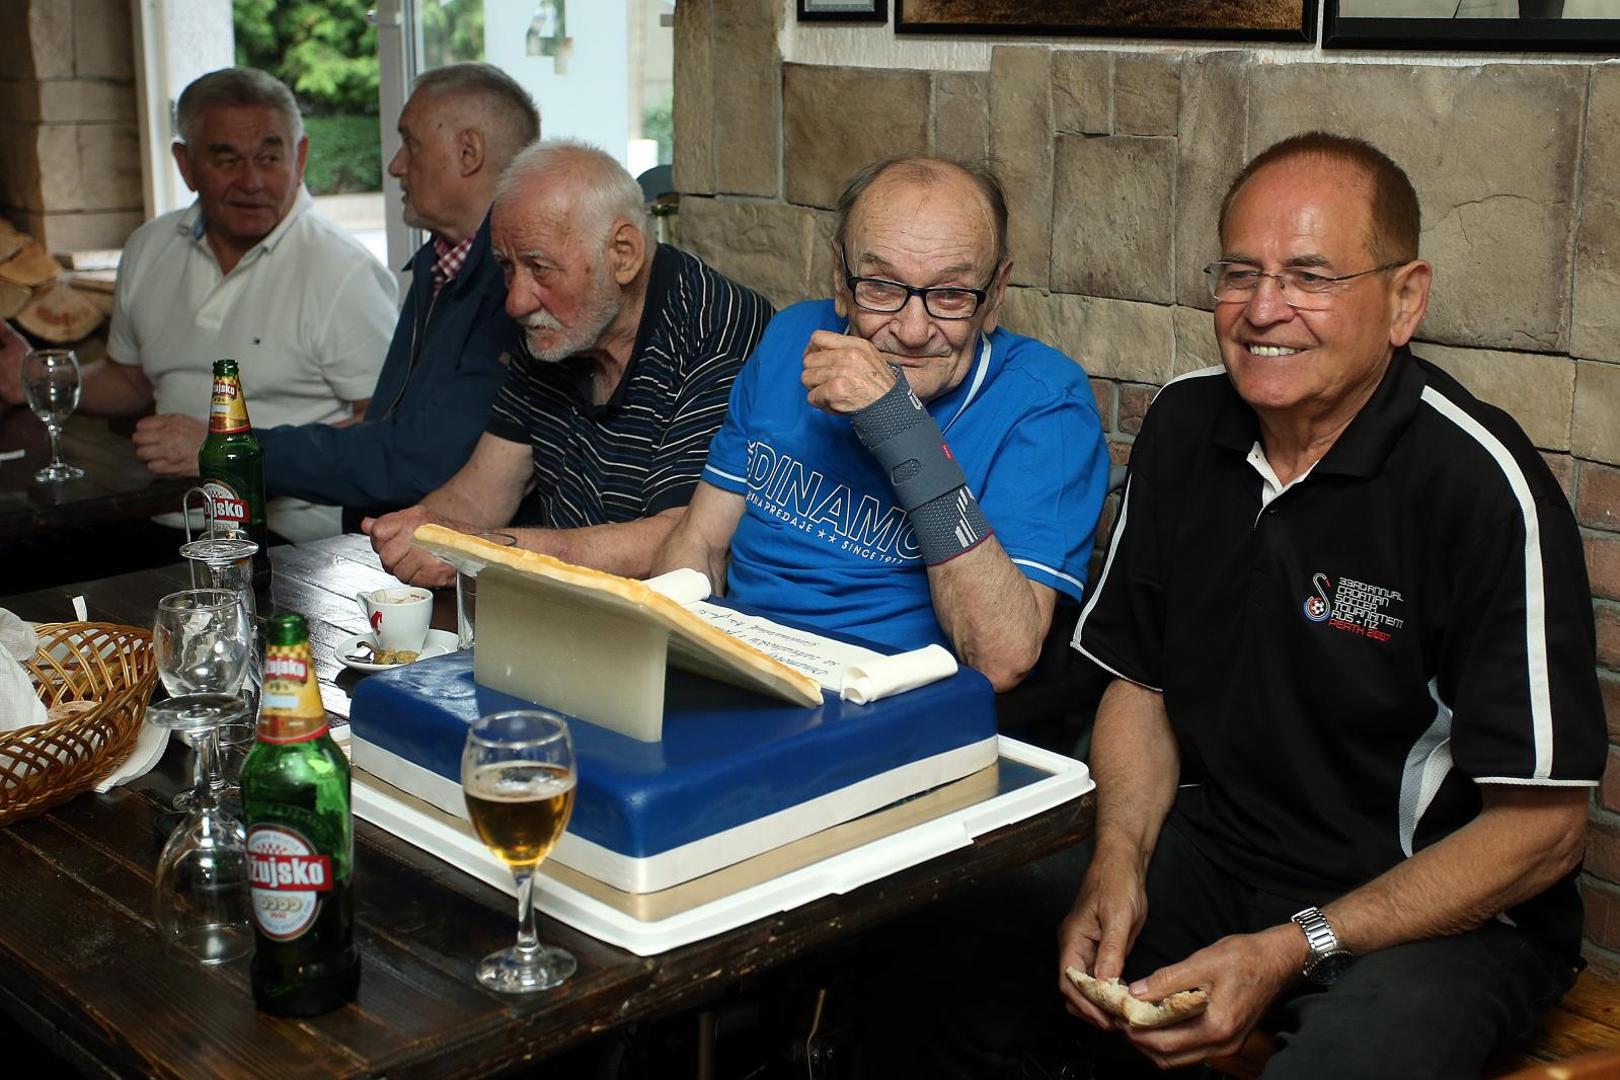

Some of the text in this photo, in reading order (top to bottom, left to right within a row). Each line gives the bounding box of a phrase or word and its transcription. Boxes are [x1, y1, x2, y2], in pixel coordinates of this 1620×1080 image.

[764, 501, 814, 533] PREDAJE
[841, 540, 877, 560] SINCE
[1335, 593, 1378, 613] SOCCER
[1337, 585, 1390, 607] CROATIAN
[1367, 585, 1404, 602] ANNUAL
[249, 854, 325, 889] žujsko
